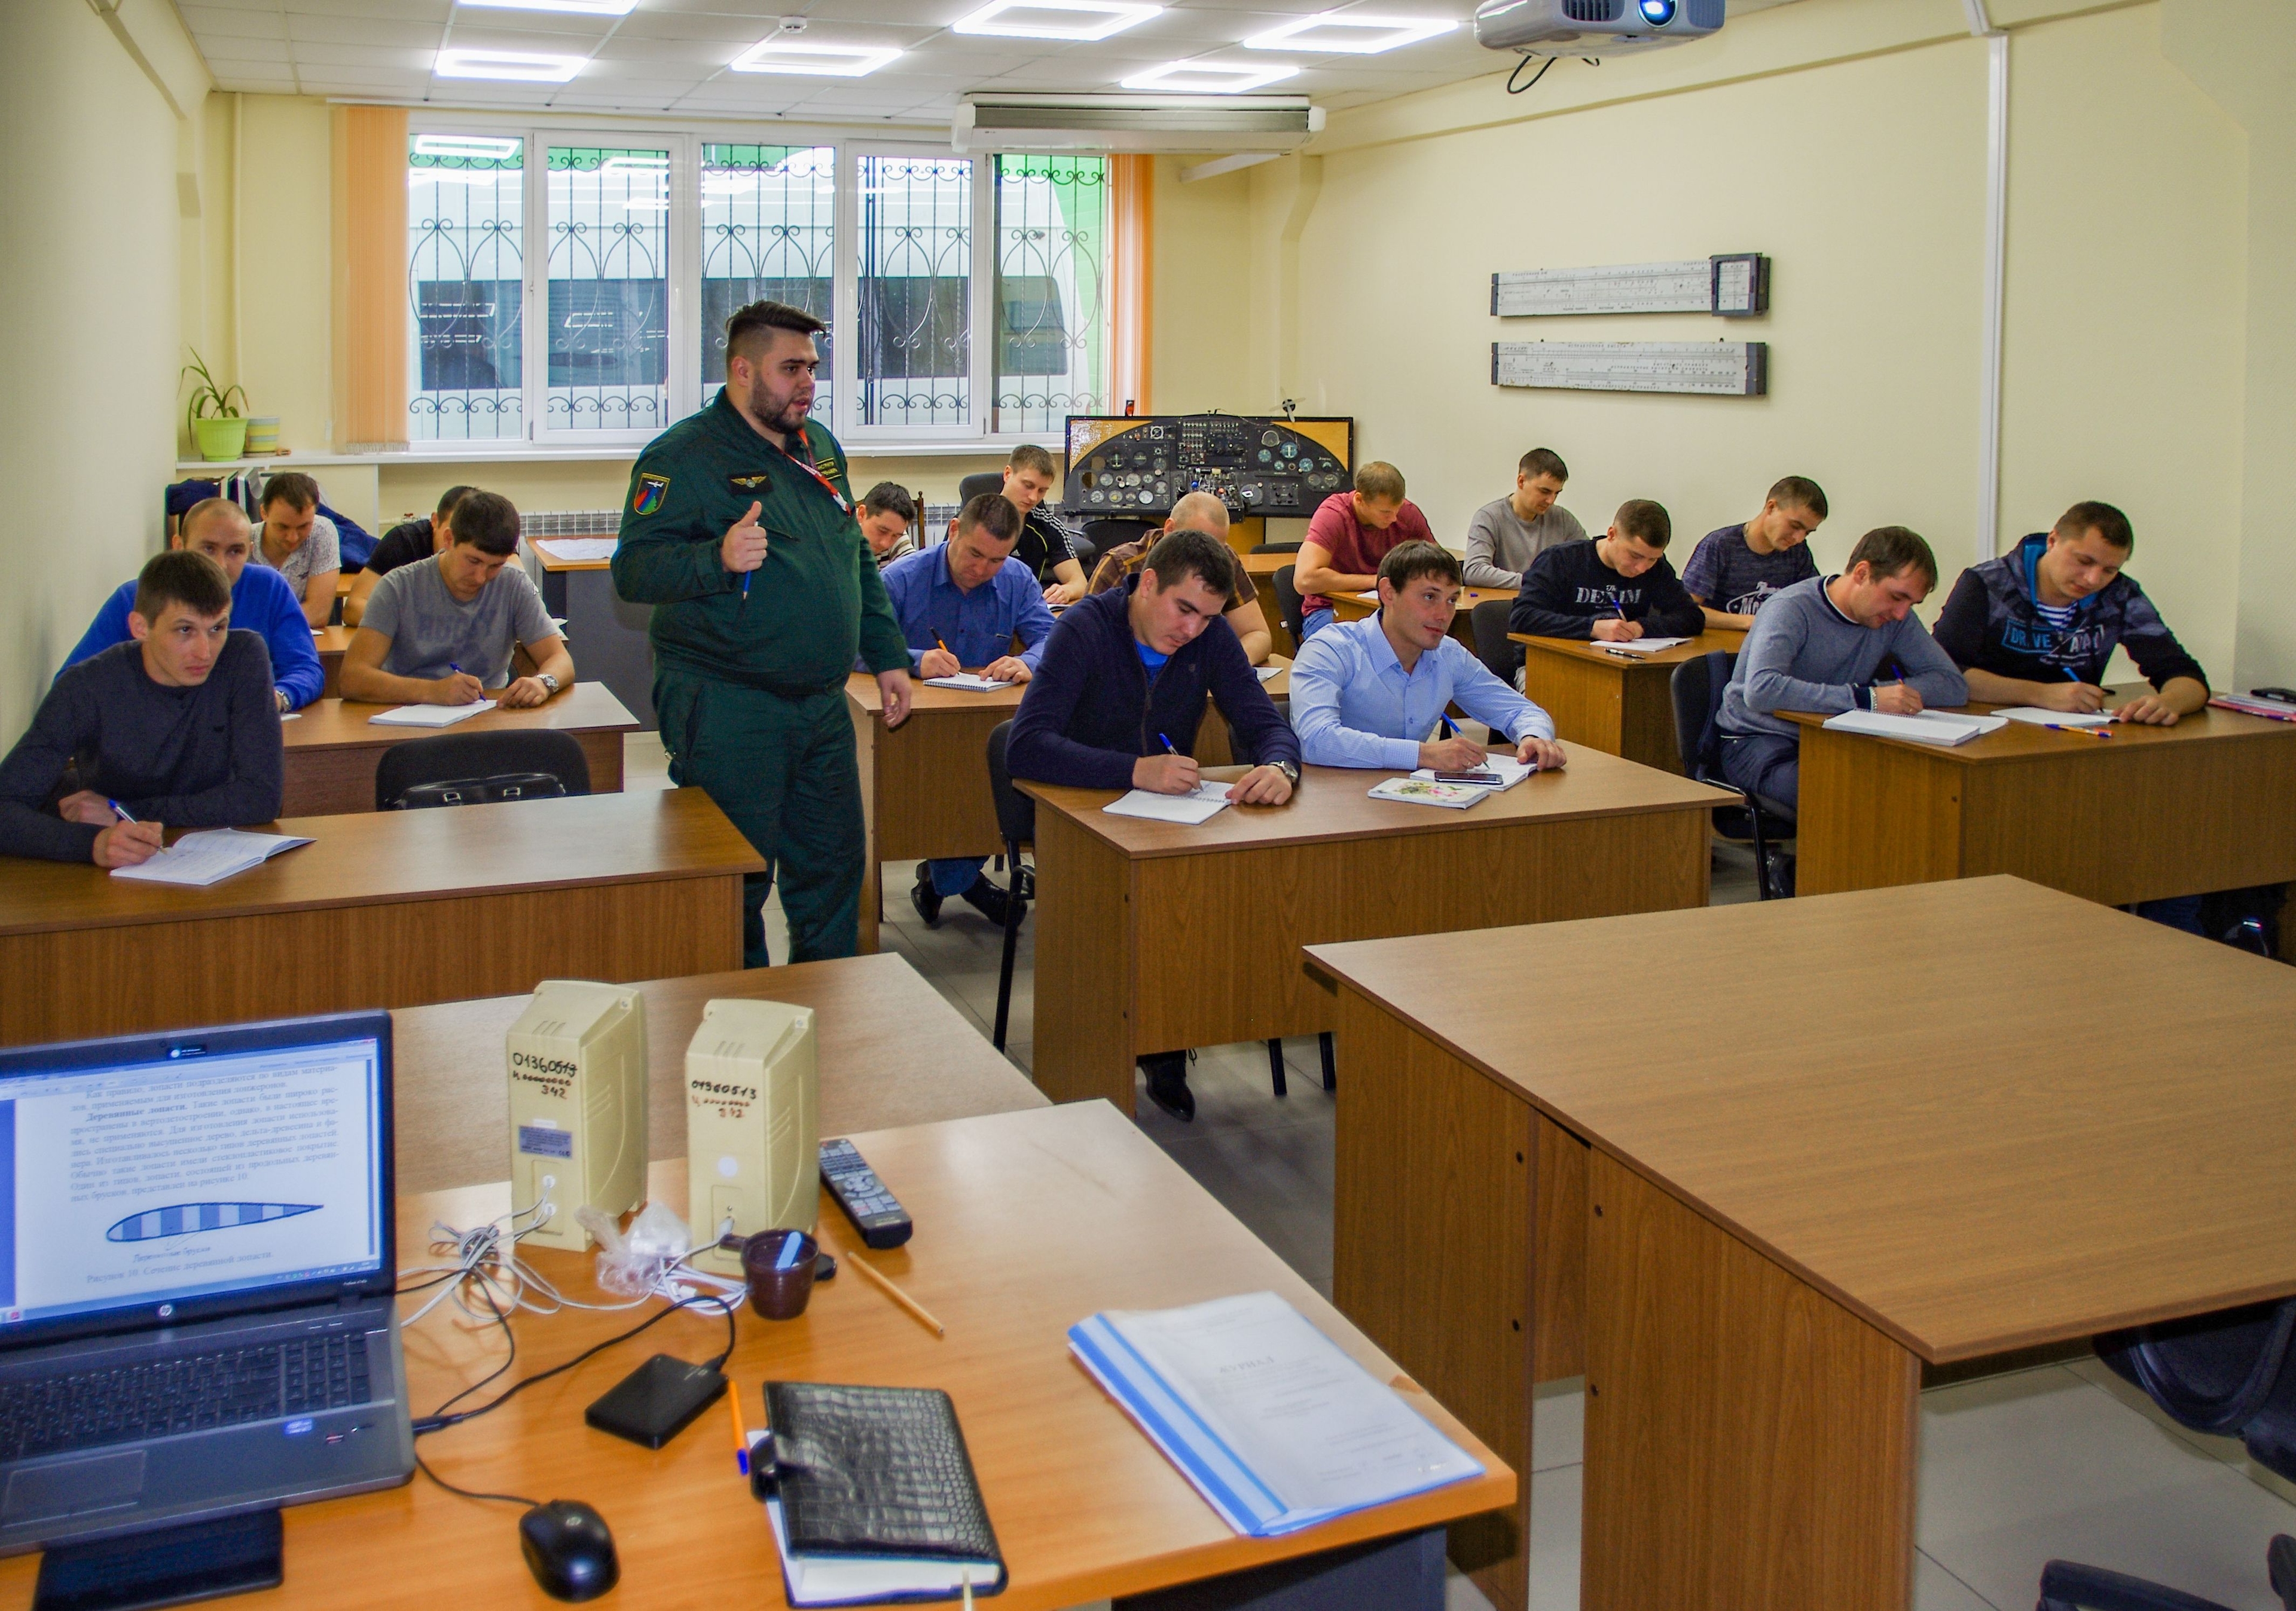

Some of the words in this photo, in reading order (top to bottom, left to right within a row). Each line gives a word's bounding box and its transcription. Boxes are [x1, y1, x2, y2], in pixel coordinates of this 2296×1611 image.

[2010, 627, 2053, 649] DRVE
[513, 1053, 578, 1078] 01360513
[541, 1081, 567, 1099] 342
[691, 1080, 757, 1099] 01360513
[86, 1109, 144, 1122] Деревянные
